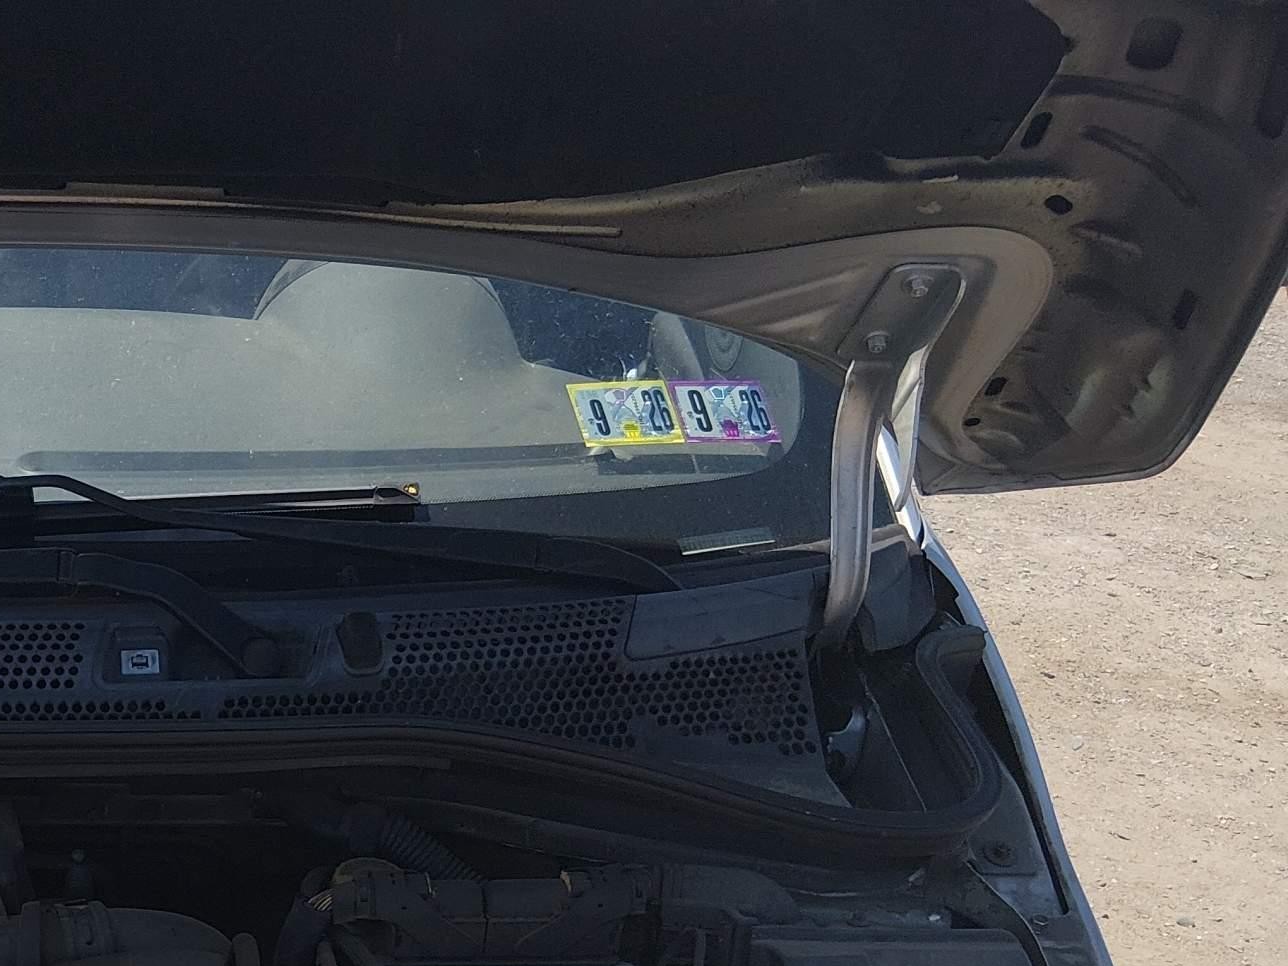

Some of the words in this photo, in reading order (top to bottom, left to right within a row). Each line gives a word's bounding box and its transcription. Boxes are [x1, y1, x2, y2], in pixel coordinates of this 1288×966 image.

[589, 398, 612, 437] 9
[639, 388, 676, 433] 26
[687, 388, 714, 434] 9
[737, 388, 771, 432] 26
